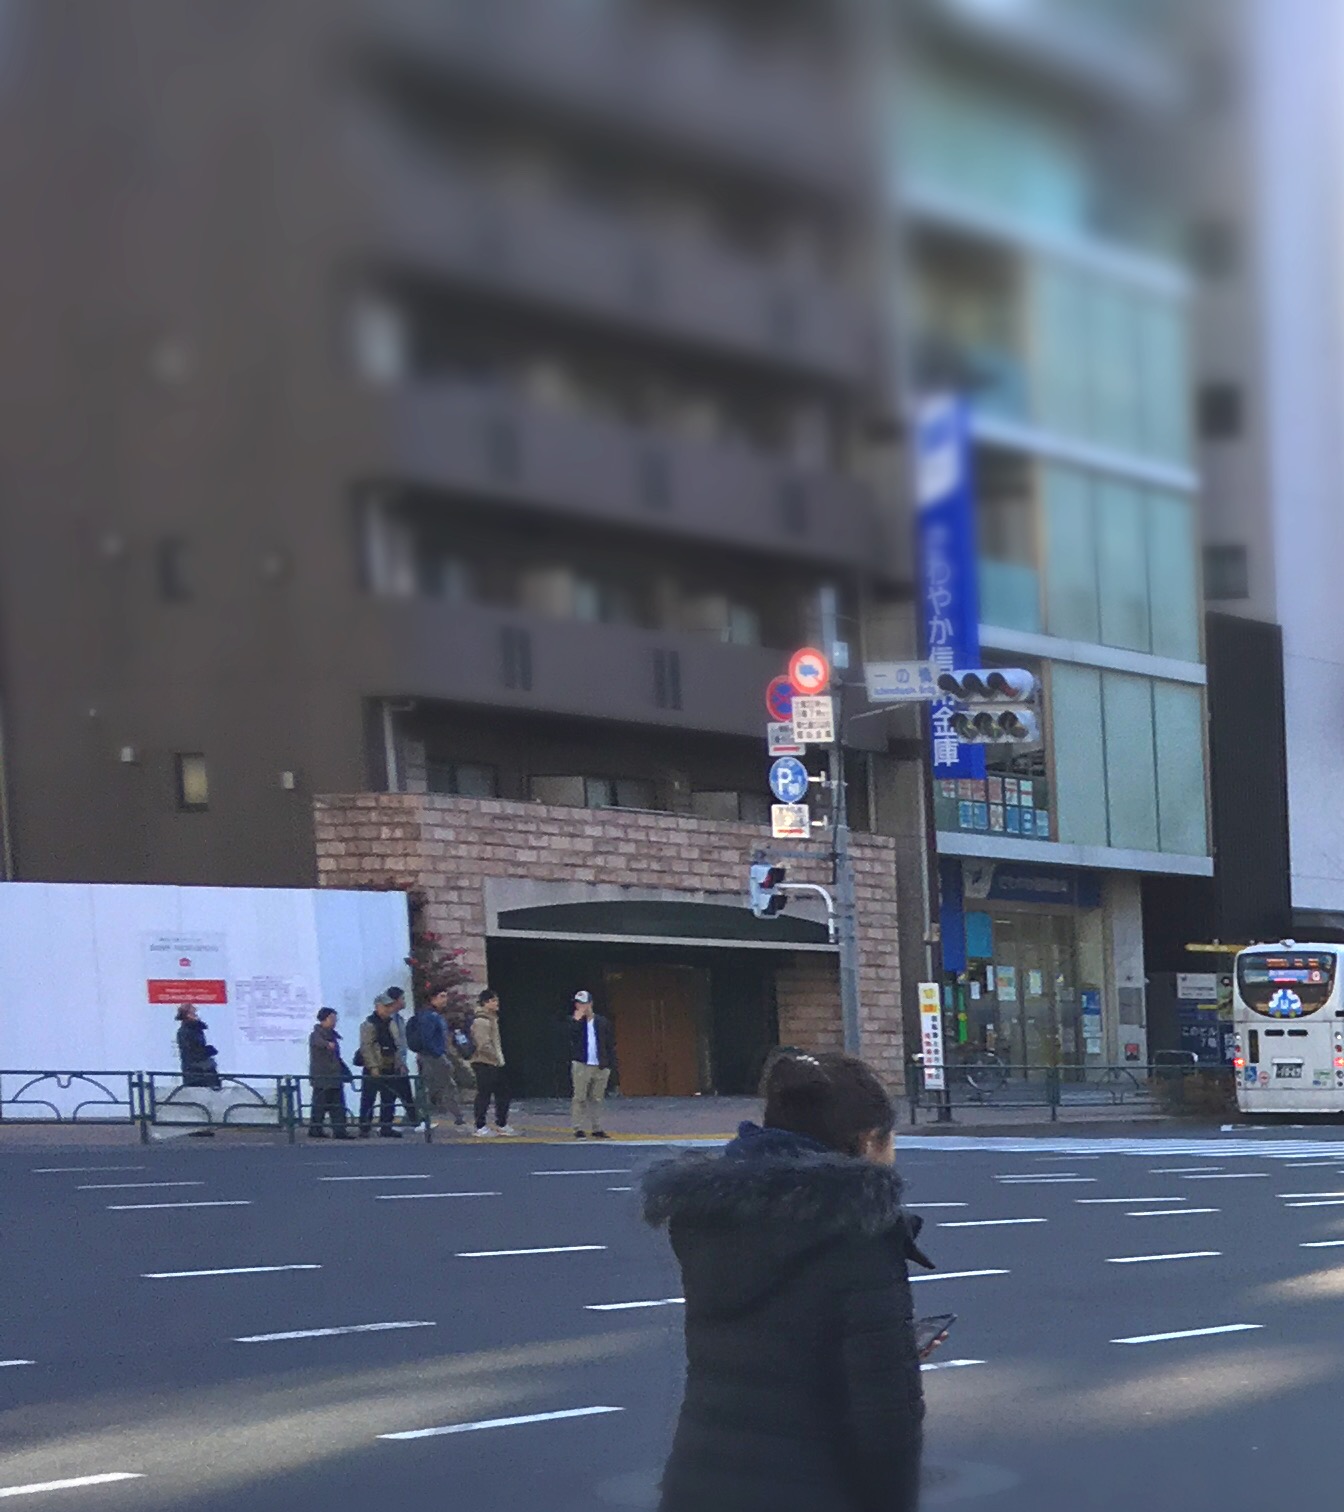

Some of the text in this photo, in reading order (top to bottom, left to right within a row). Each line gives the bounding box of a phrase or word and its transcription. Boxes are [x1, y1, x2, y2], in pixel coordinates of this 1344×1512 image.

[927, 524, 960, 767] わやか信金庫
[777, 768, 793, 796] P
